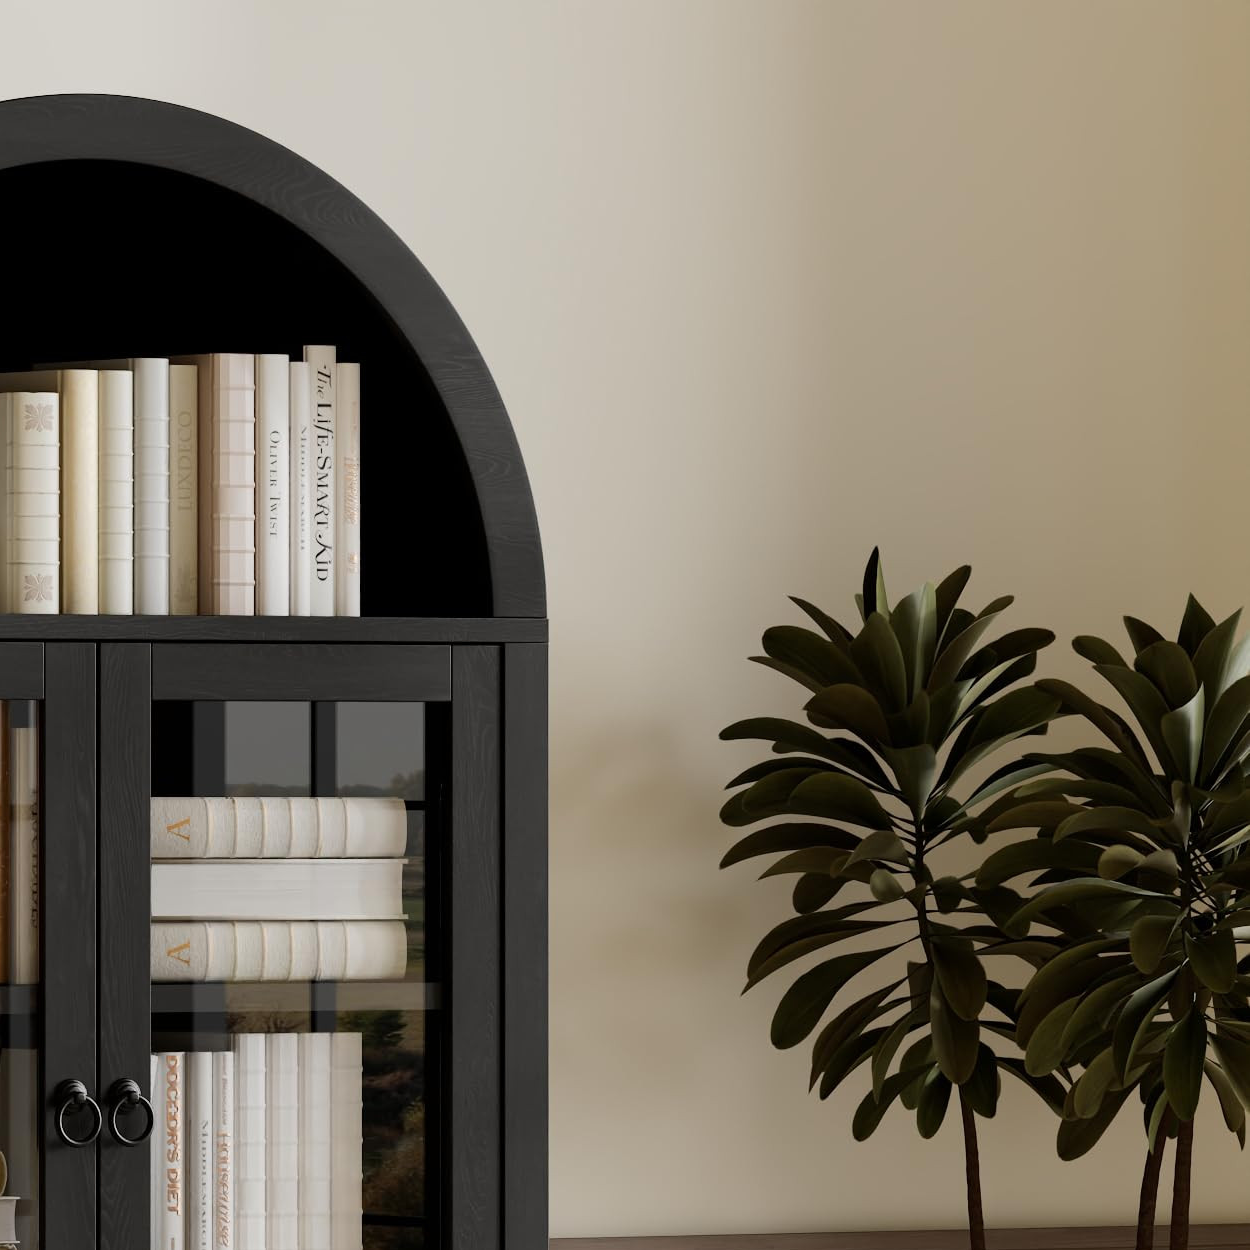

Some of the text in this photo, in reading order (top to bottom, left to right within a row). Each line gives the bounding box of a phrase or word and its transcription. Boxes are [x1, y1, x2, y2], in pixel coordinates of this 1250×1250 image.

[167, 816, 190, 841] A
[167, 940, 190, 966] A
[166, 1168, 180, 1216] DIET
